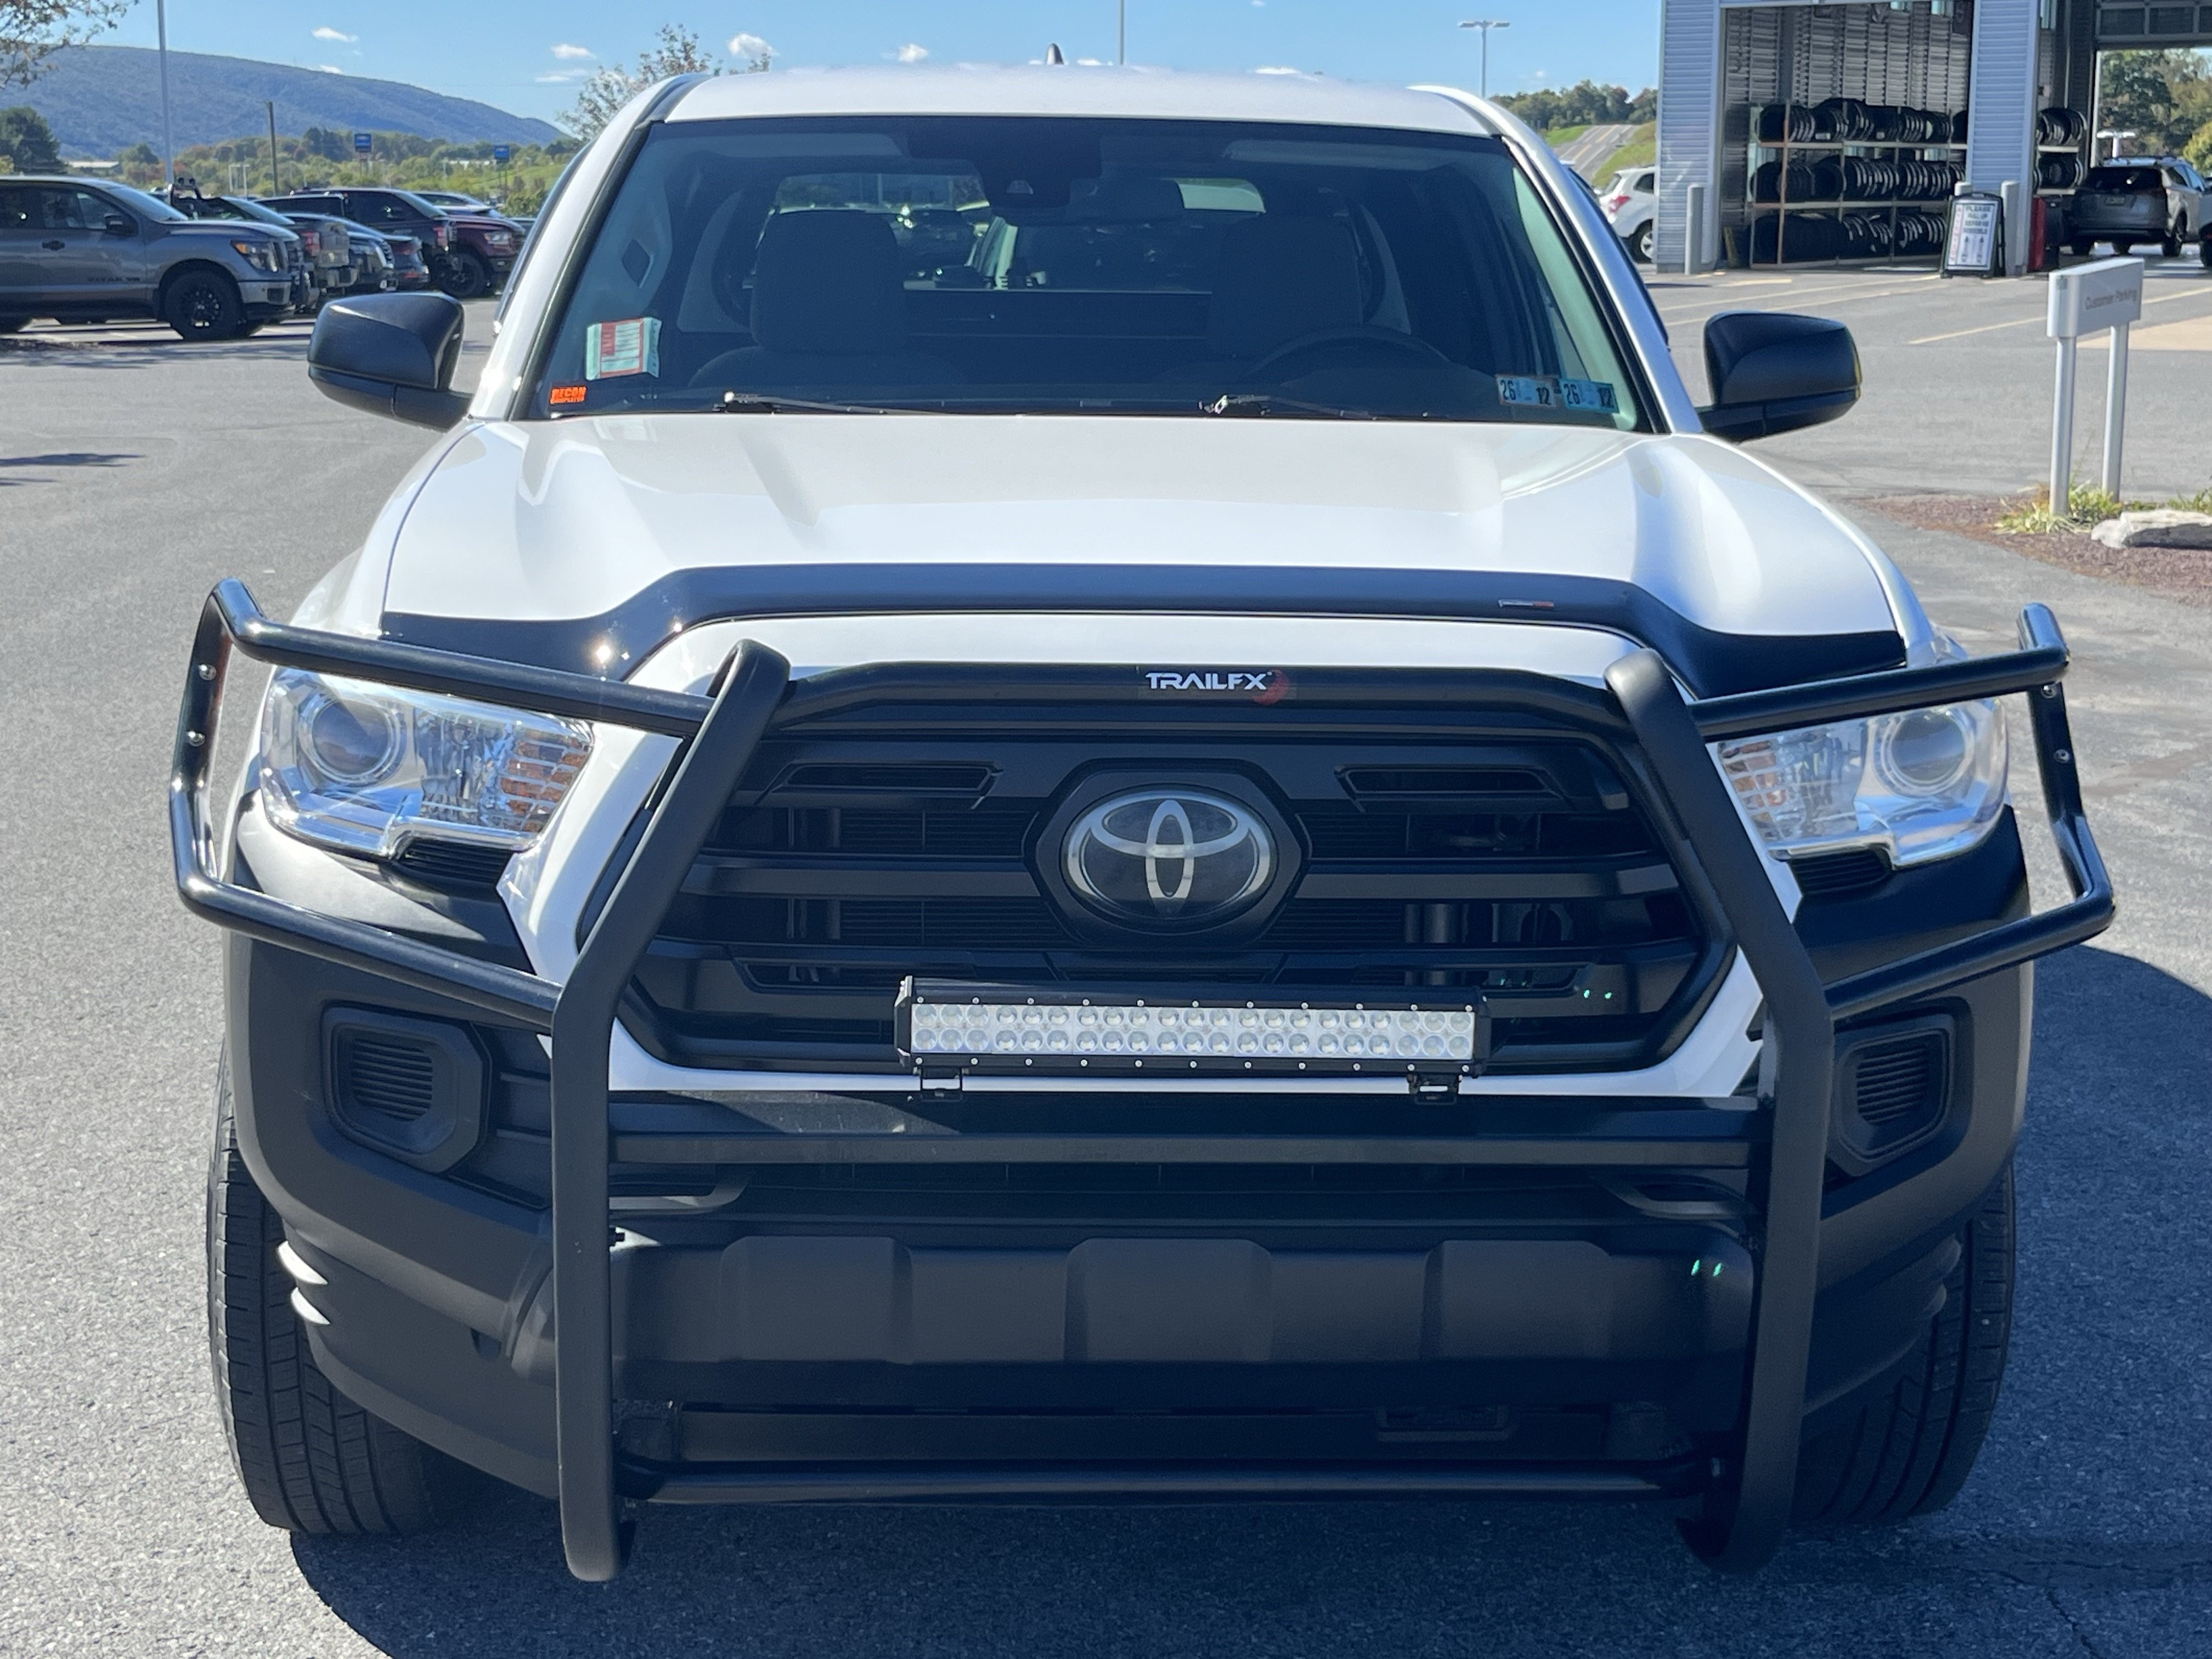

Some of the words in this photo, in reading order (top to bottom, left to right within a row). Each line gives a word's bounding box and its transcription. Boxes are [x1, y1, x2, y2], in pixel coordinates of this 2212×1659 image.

[2085, 295, 2114, 311] Customer
[1500, 379, 1516, 400] 26
[1536, 386, 1552, 406] 12
[1563, 383, 1581, 405] 26
[1597, 387, 1616, 409] 12
[1145, 672, 1267, 690] TRAILFX
